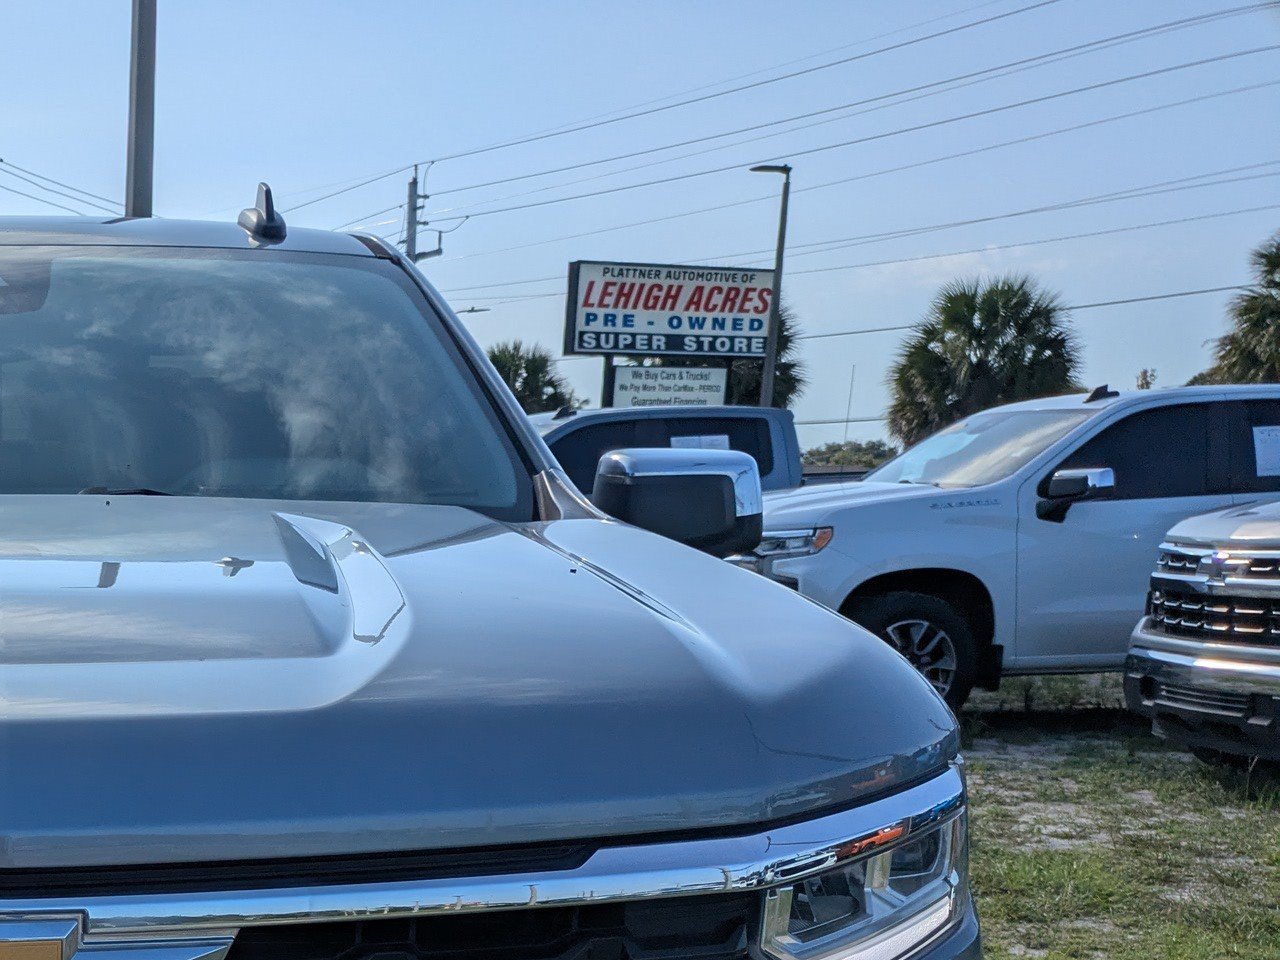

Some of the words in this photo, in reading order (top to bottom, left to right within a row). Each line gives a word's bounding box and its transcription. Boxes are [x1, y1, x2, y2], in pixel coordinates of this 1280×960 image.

[602, 267, 661, 280] PLATTNER
[665, 269, 738, 283] AUTOMOTIVE
[741, 273, 757, 283] OF
[582, 280, 683, 312] LEHIGH
[683, 285, 773, 315] ACRES
[584, 312, 635, 328] PRE
[667, 315, 764, 331] OWNED
[582, 332, 667, 350] SUPER
[683, 335, 765, 353] STORE
[631, 370, 643, 380] We
[644, 370, 659, 382] Buy
[660, 370, 677, 380] Cars
[677, 371, 684, 380] &
[631, 396, 673, 406] Guaranteed
